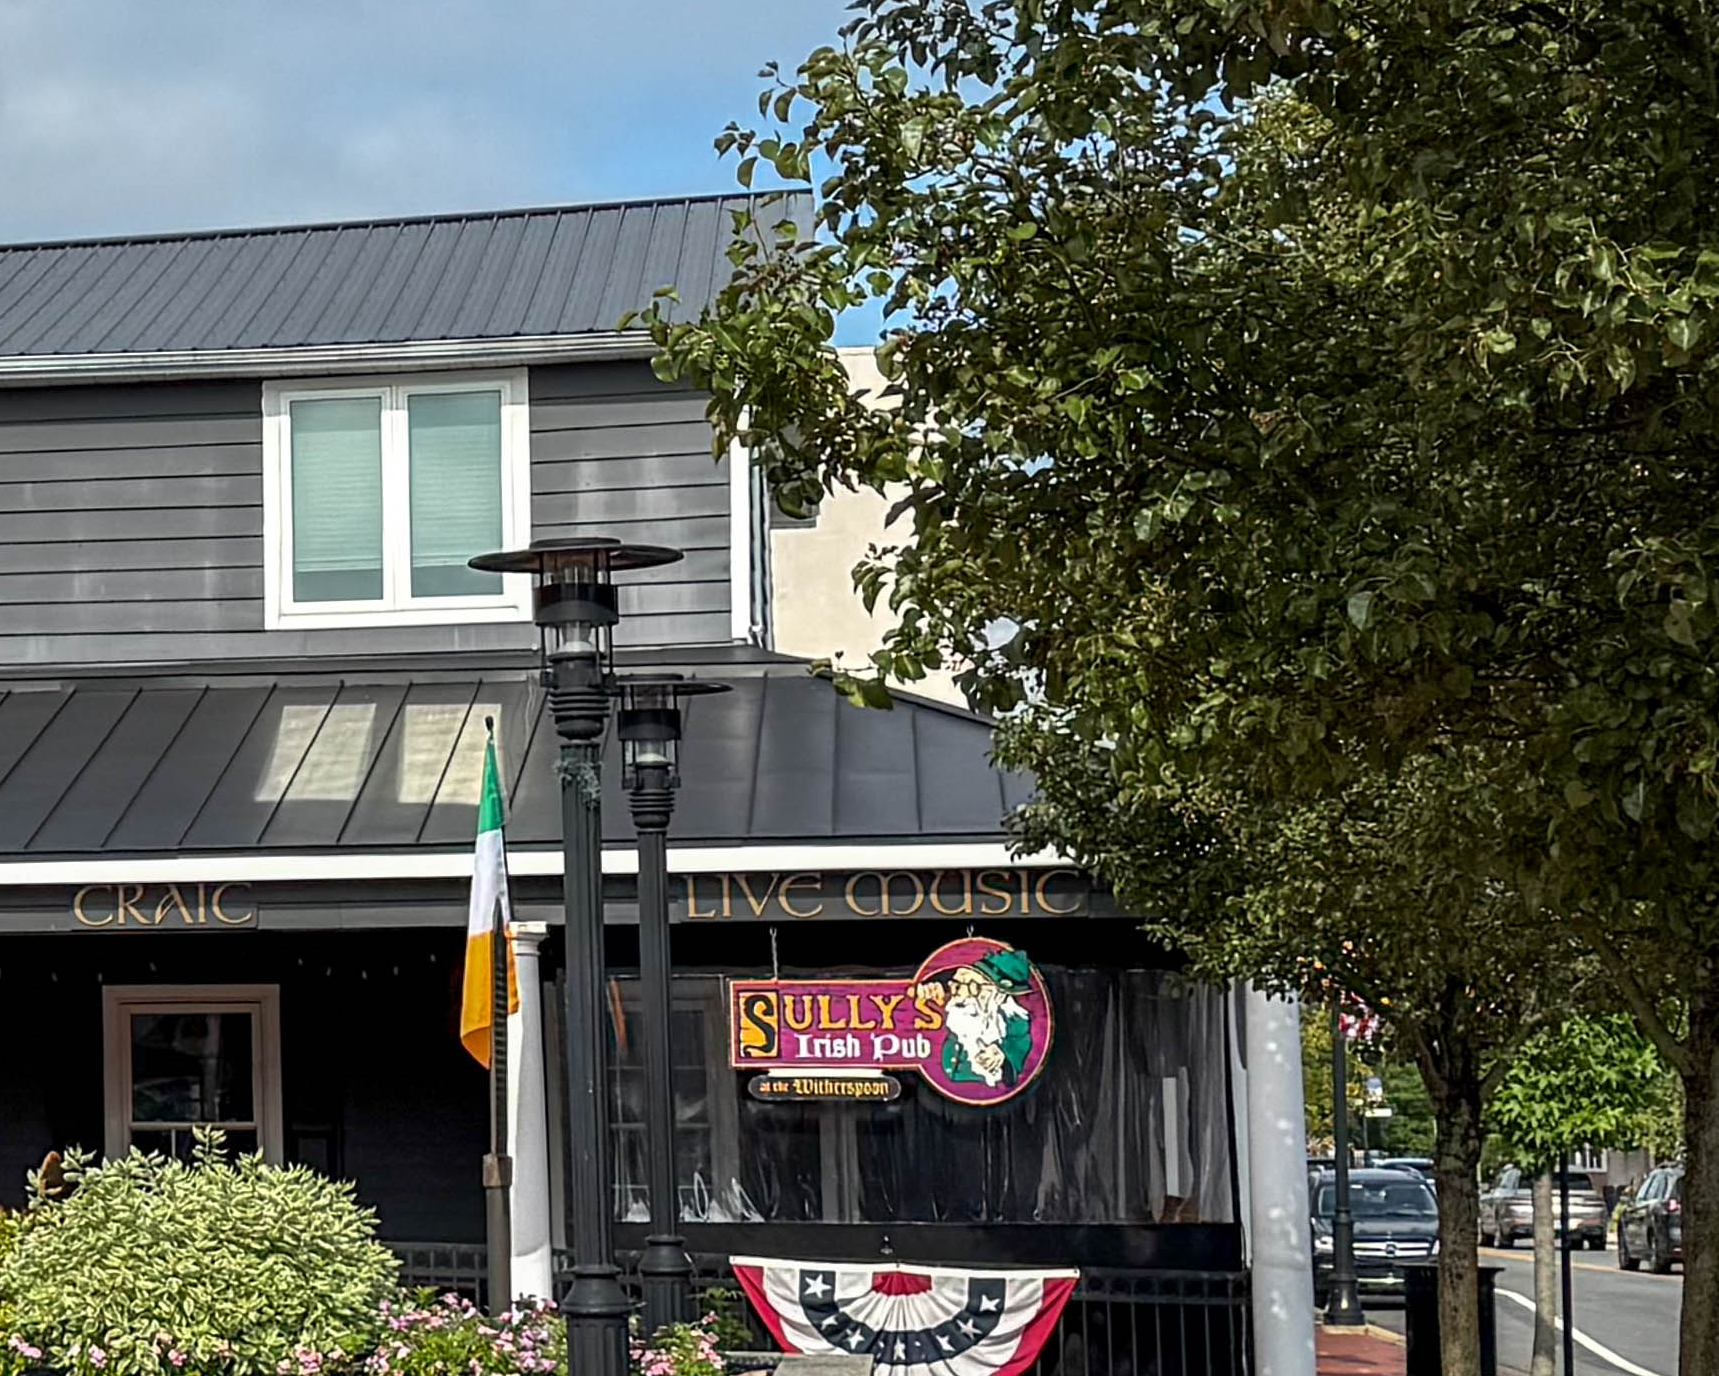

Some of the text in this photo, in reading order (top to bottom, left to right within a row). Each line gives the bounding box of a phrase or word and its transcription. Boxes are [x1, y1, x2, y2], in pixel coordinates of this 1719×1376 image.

[74, 883, 252, 926] CRAIC
[682, 869, 1082, 919] LIVE MUSIC
[739, 988, 945, 1058] SULLY'S
[794, 1033, 931, 1062] Irish Pub
